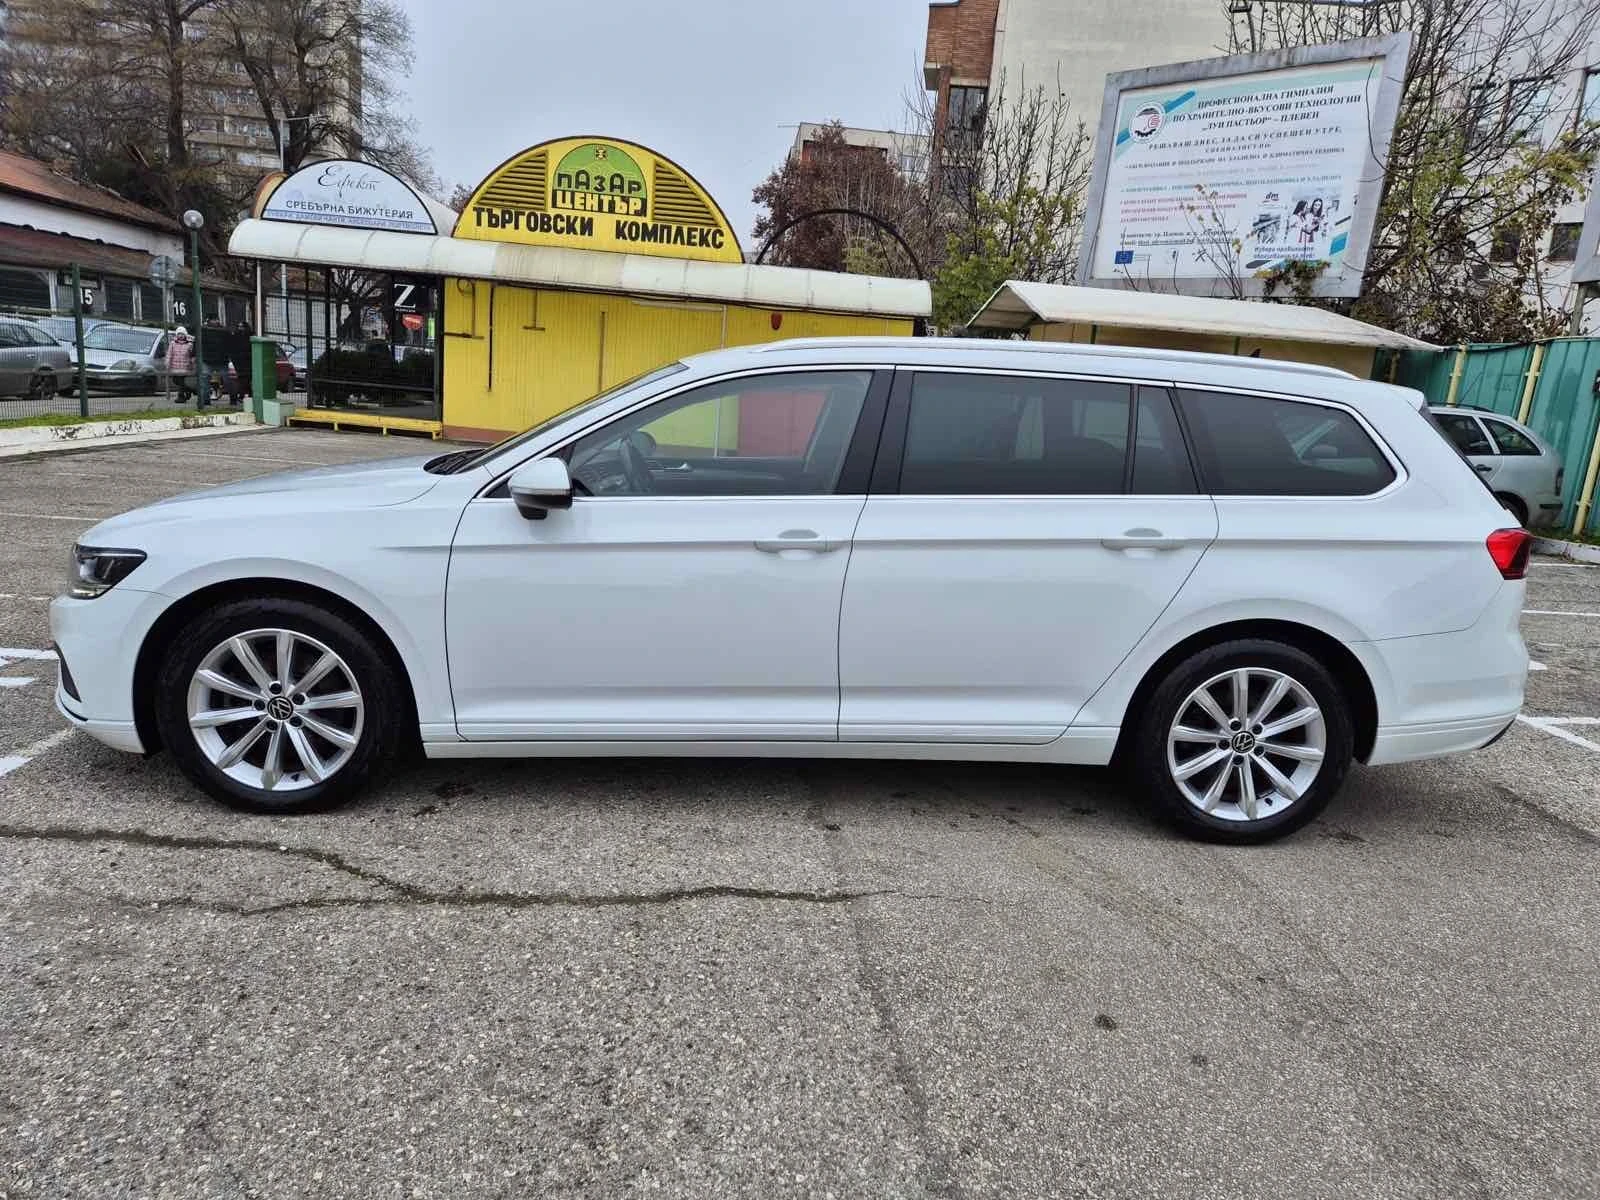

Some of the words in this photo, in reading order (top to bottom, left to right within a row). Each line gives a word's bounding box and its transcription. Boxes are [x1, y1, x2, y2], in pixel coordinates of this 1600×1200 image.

[1173, 114, 1186, 123] ПО
[1187, 103, 1292, 121] ХРАНИТЕЛНО-ВКУСОВИ
[1294, 94, 1362, 110] ТЕХНОЛОГИИ
[1198, 92, 1279, 109] ПРОФЕСИОНАЛНА
[1280, 85, 1334, 99] ГИМНАЗИЯ
[1280, 111, 1319, 123] ПЛЕВЕН
[557, 168, 642, 195] ПАЗАР
[286, 200, 345, 214] СРЕБЪРНА
[349, 205, 413, 219] БИЖУТЕРИЯ
[555, 190, 644, 216] ЦЕНТЪР
[473, 206, 594, 237] ТЪРГОВСКИ
[615, 219, 725, 249] КОМПЛЕКС
[80, 287, 93, 305] 15
[173, 301, 186, 316] 16
[393, 283, 416, 309] Z
